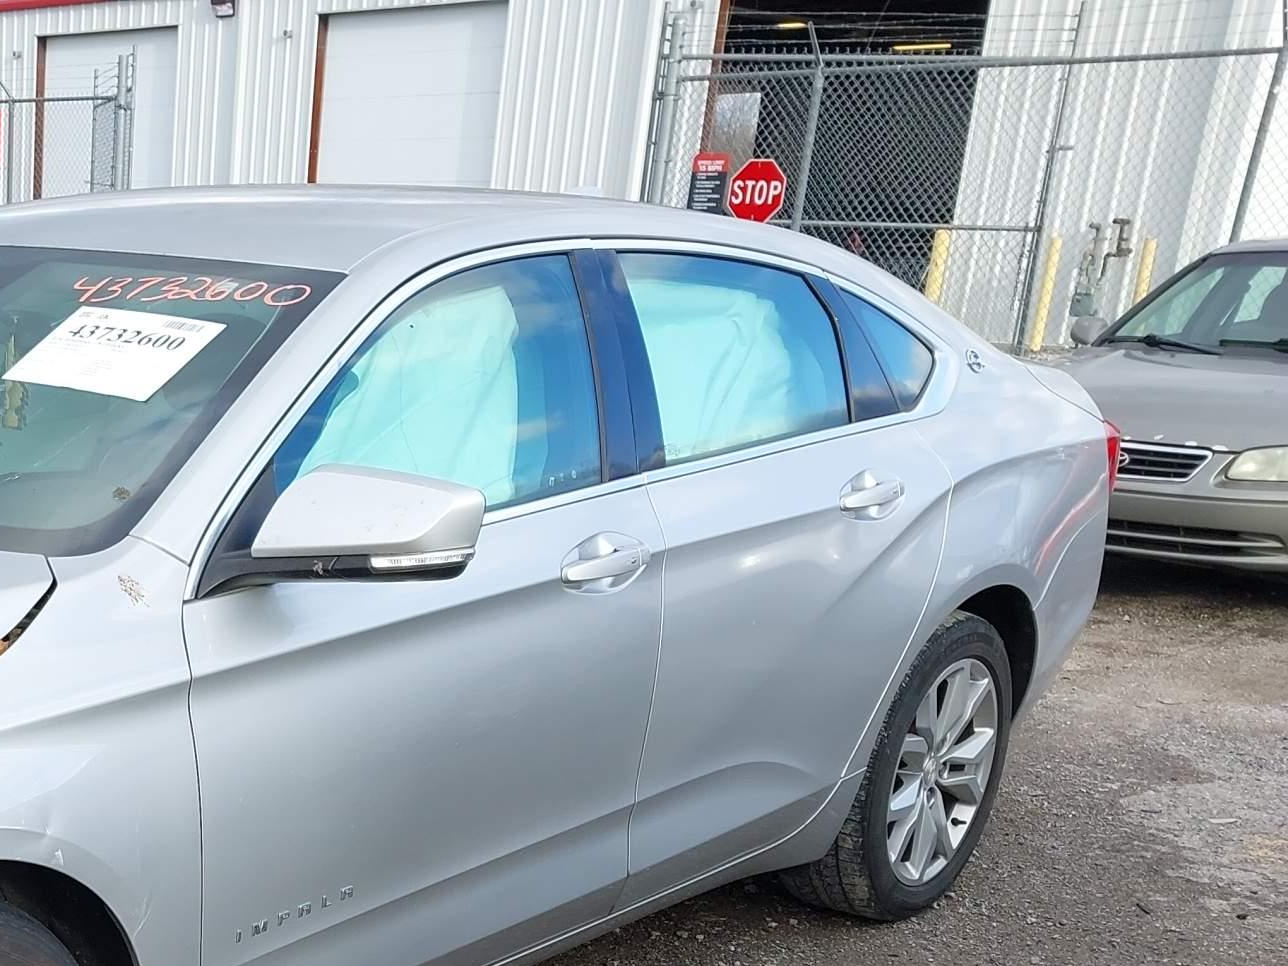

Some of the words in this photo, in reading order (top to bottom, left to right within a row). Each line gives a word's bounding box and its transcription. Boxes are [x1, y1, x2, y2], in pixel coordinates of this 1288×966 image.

[731, 179, 782, 205] STOP
[72, 276, 312, 306] 43732600
[68, 324, 186, 351] 43732600
[235, 885, 354, 943] IMPALA
